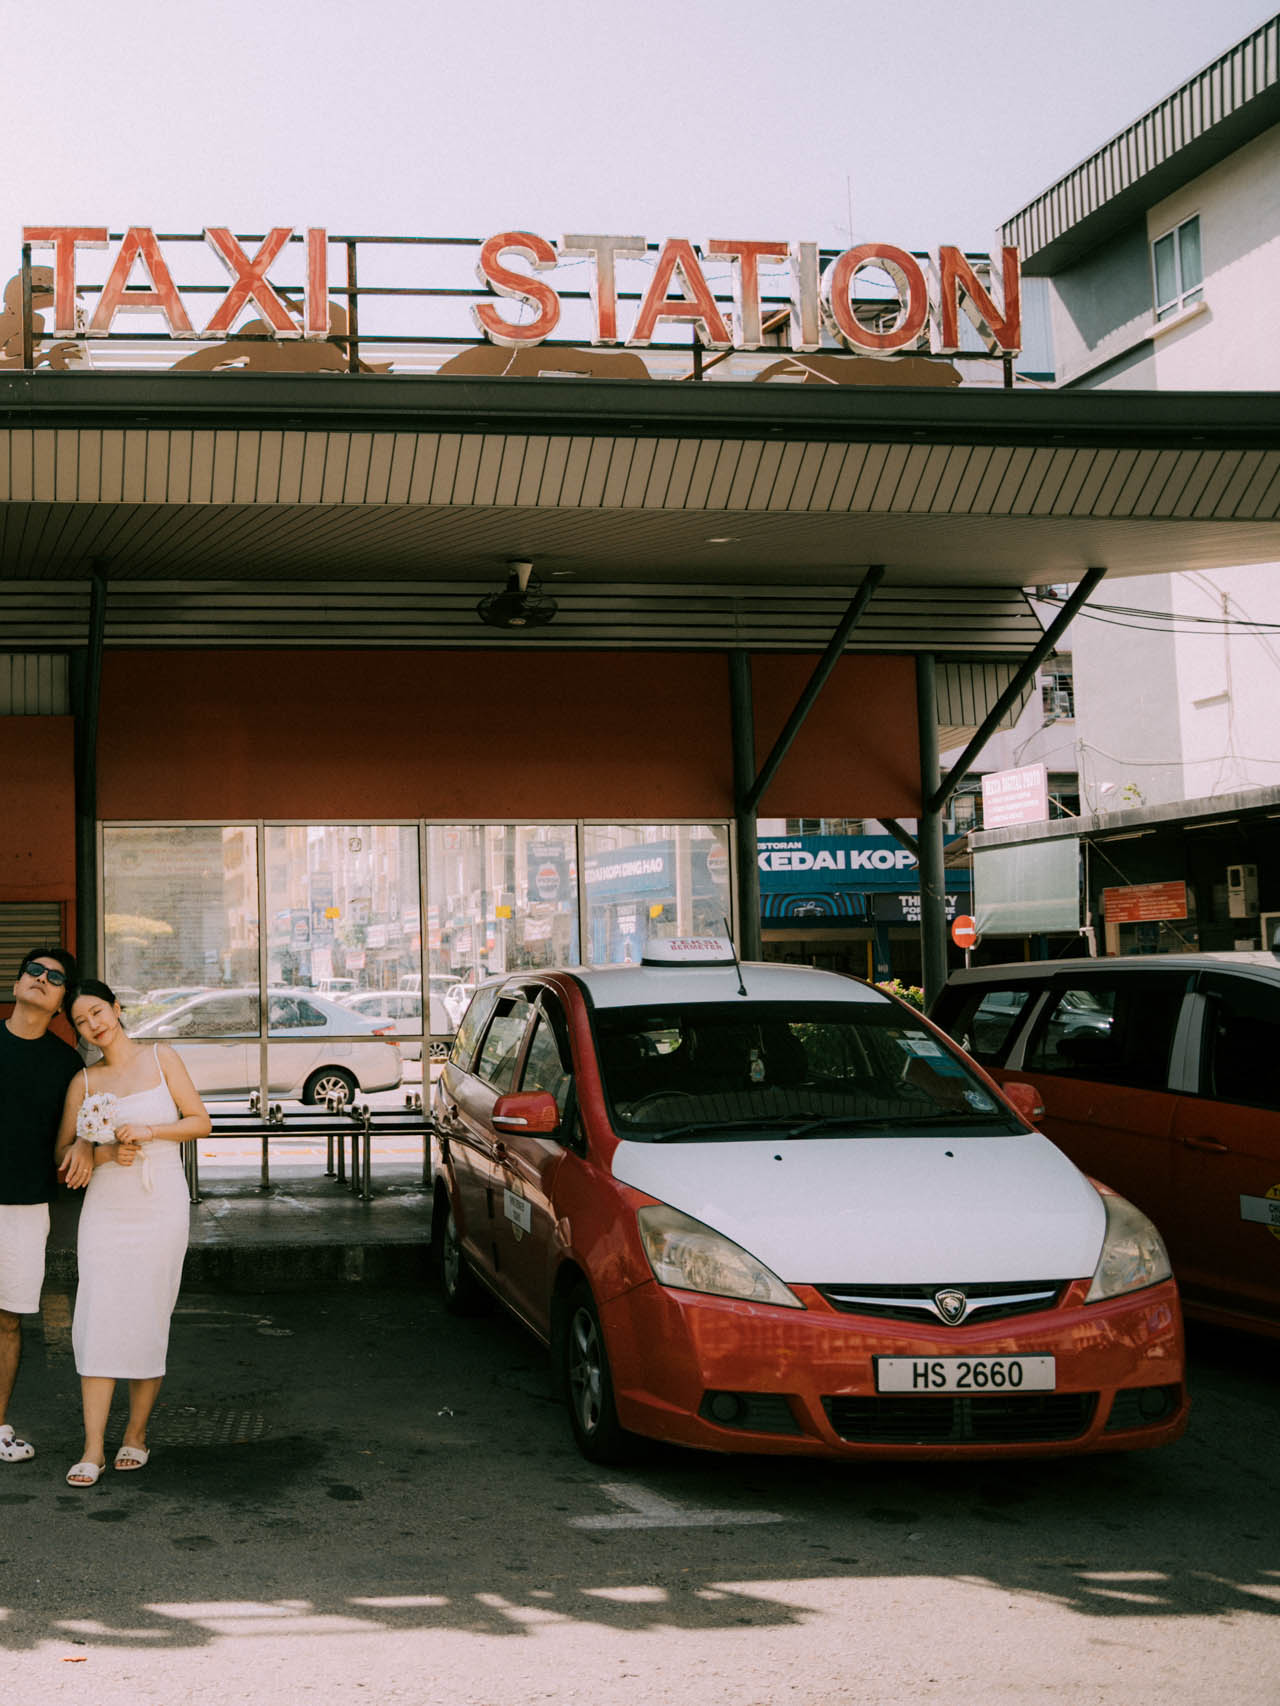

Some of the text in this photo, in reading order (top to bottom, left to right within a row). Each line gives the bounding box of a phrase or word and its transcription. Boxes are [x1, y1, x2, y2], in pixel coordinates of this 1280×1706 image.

[22, 225, 329, 341] TAXI
[474, 230, 1022, 356] STATION
[757, 849, 918, 871] KEDAI KOP
[912, 1360, 1023, 1388] HS 2660
